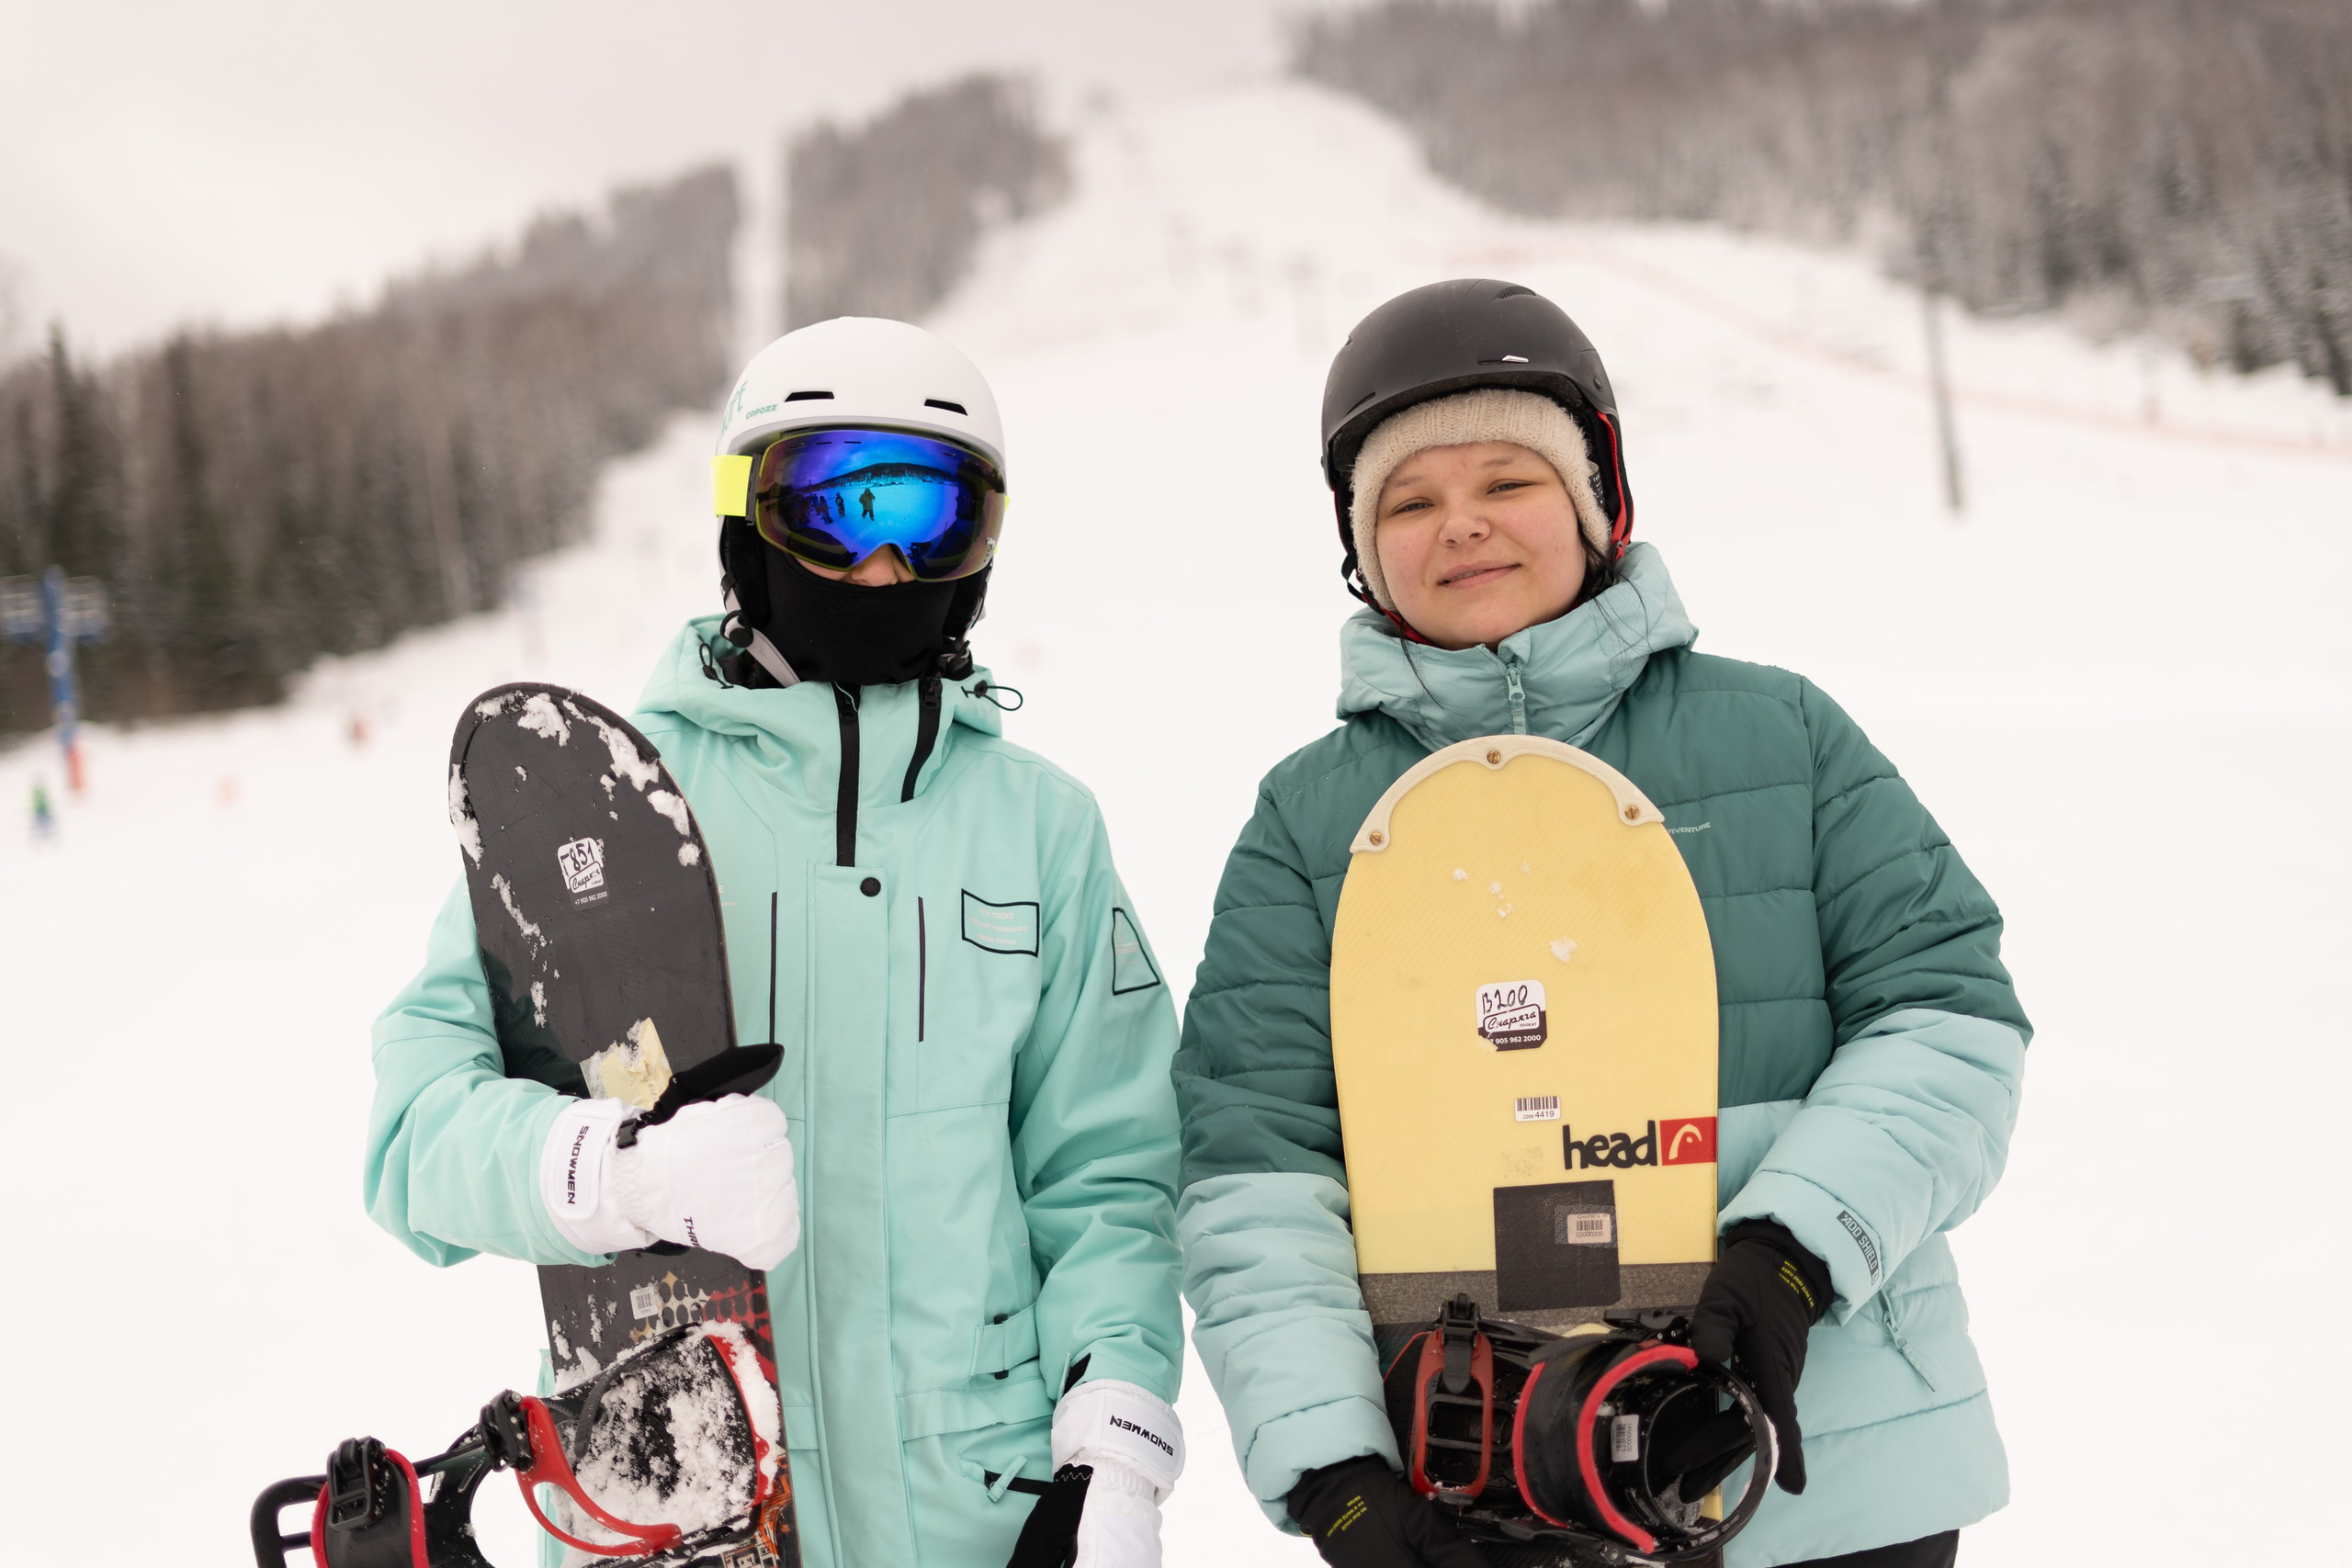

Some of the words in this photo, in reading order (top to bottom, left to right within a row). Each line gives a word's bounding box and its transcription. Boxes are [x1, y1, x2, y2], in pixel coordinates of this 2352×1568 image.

[745, 404, 778, 420] COPOZZ
[991, 911, 1014, 919] TREND
[1487, 1011, 1537, 1030] Снаряга
[1522, 1034, 1542, 1043] 2000
[1534, 1110, 1555, 1118] 4419
[1562, 1119, 1657, 1170] head
[567, 1125, 590, 1204] SNOWMEN
[1840, 1217, 1862, 1237] ADD
[1858, 1235, 1878, 1270] SHIELD
[1109, 1415, 1174, 1457] SNOWMEN
